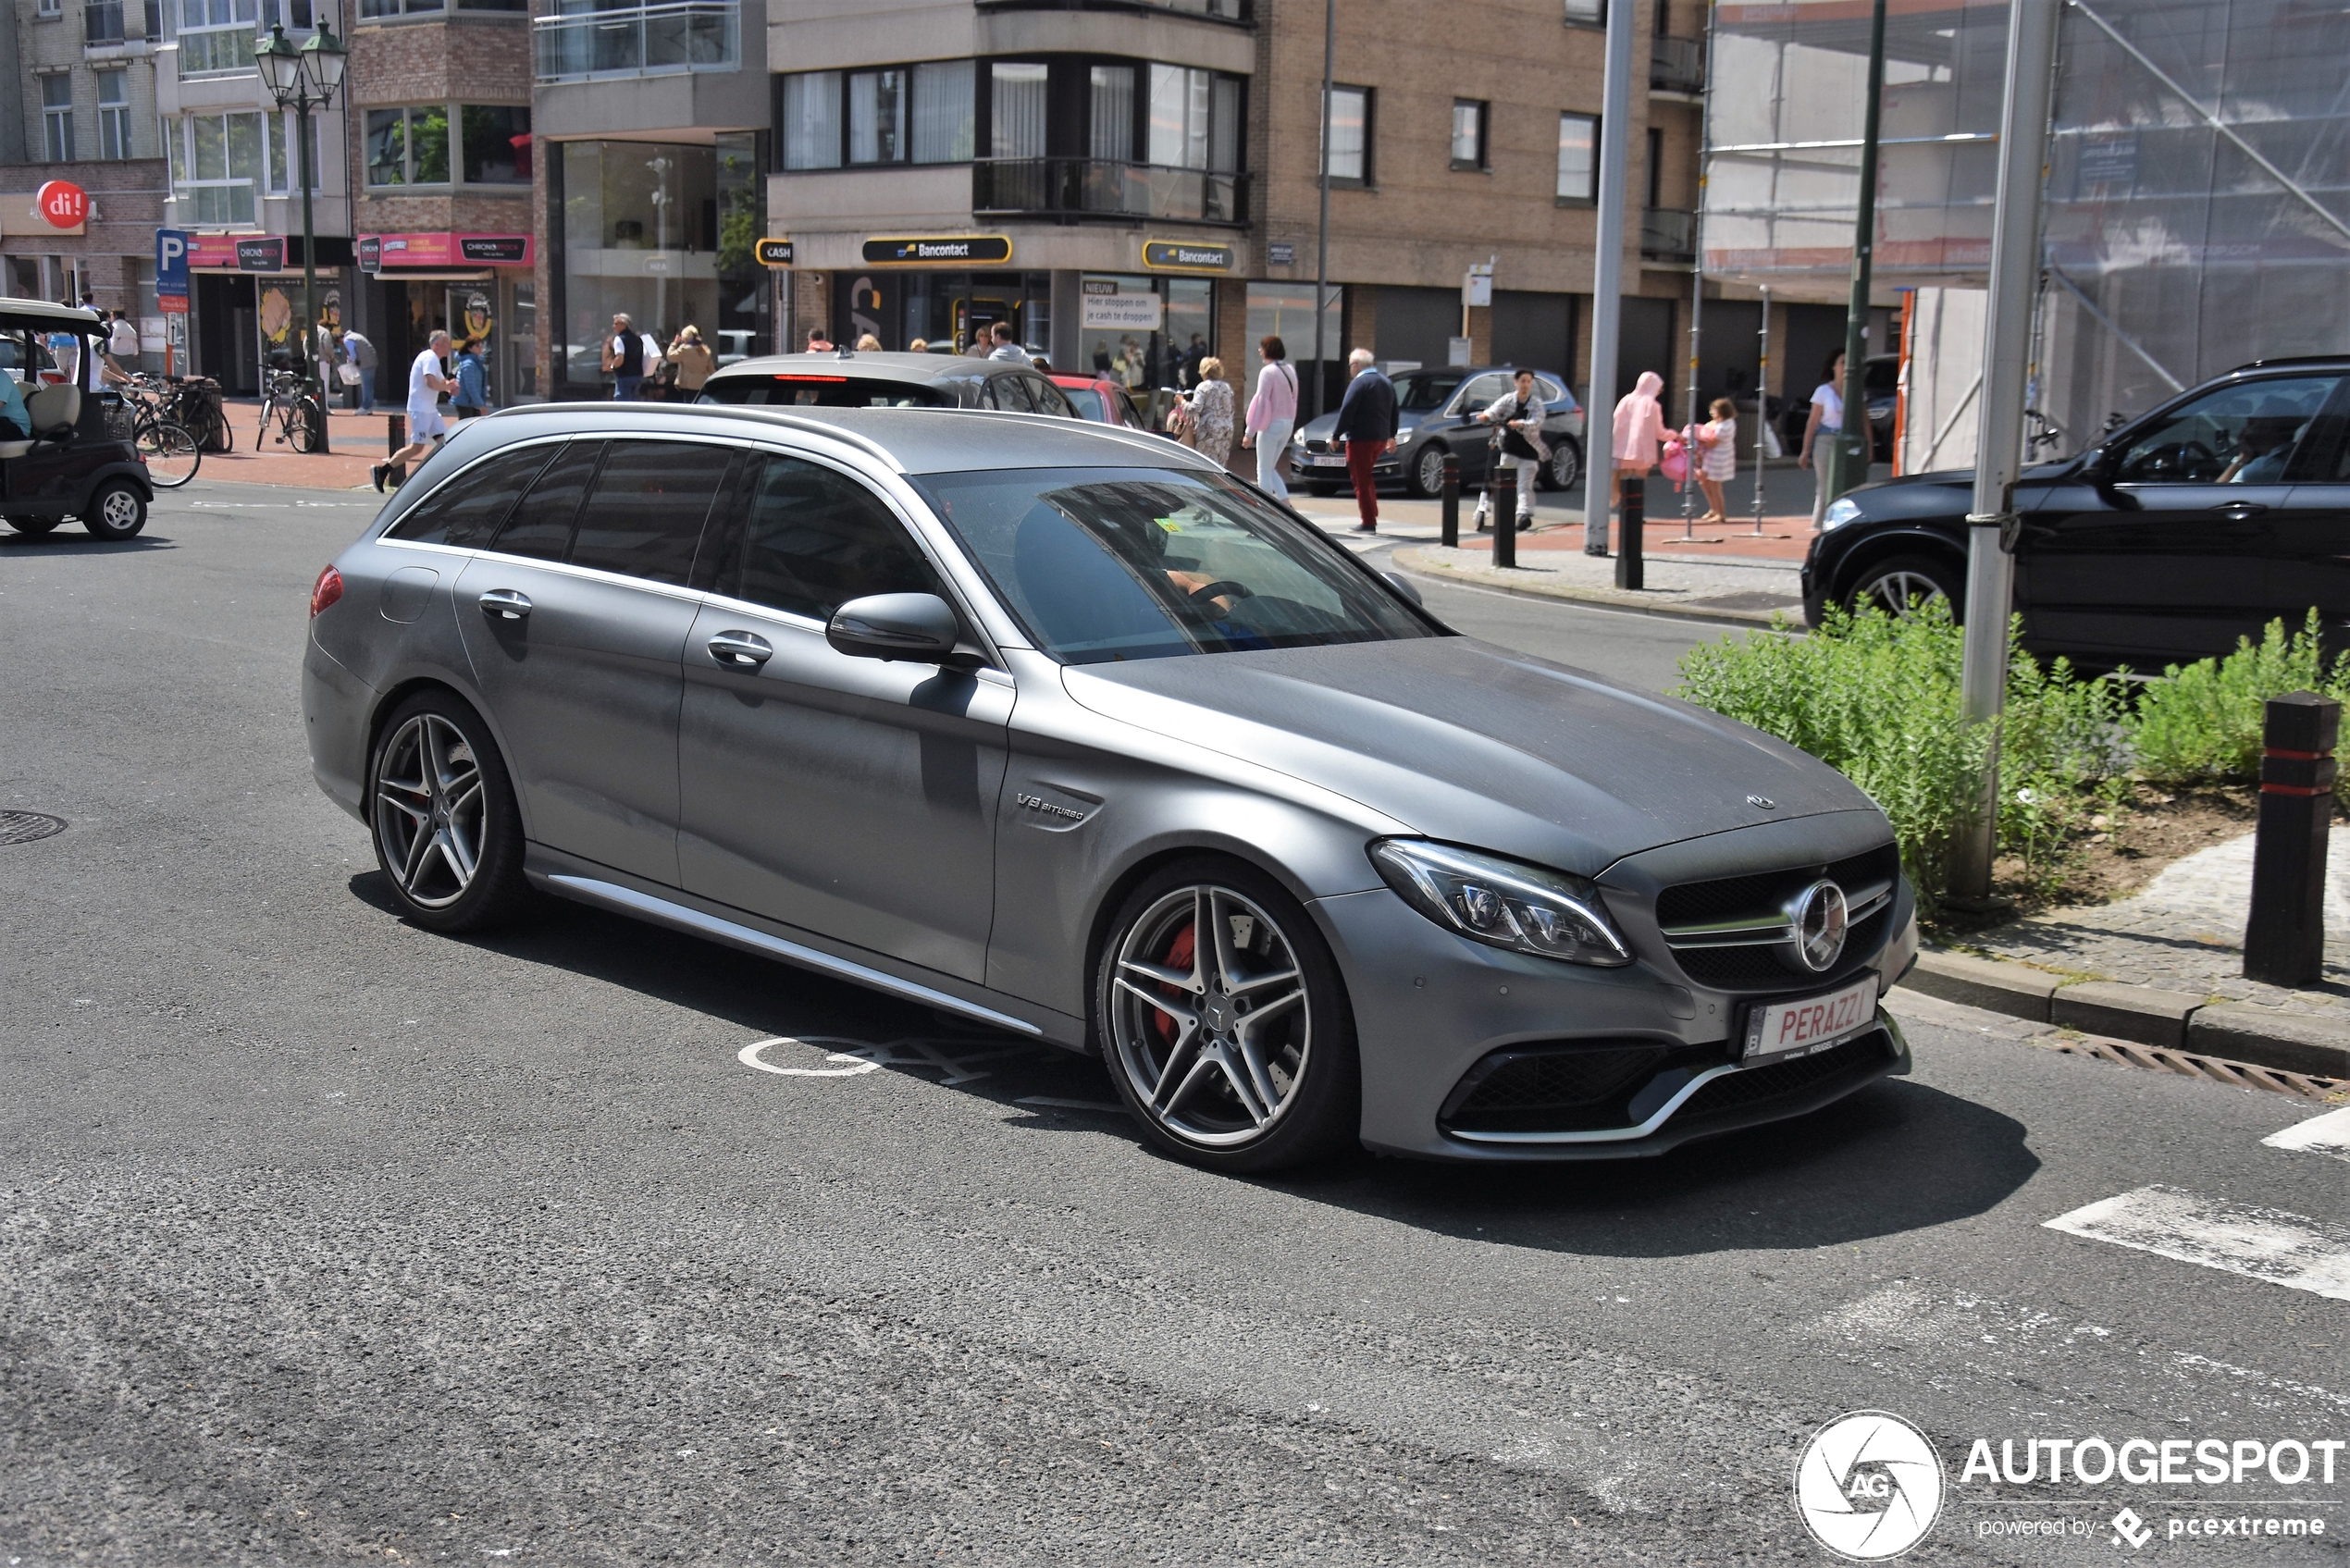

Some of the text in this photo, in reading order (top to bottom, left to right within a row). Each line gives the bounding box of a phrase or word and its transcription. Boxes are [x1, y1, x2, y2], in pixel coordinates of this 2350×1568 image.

[50, 192, 81, 216] di!
[161, 237, 183, 270] P
[767, 246, 791, 258] CASH
[918, 243, 969, 257] Bancontact
[1178, 250, 1223, 265] Bancontact
[1085, 283, 1114, 294] NIEUW
[1087, 297, 1147, 309] Hier stoppen om
[1086, 311, 1095, 321] je
[1095, 311, 1112, 320] cash
[1113, 312, 1121, 320] te
[1017, 793, 1084, 821] V8 BITURBO
[1779, 990, 1865, 1043] PERAZZI
[1748, 1034, 1760, 1051] B
